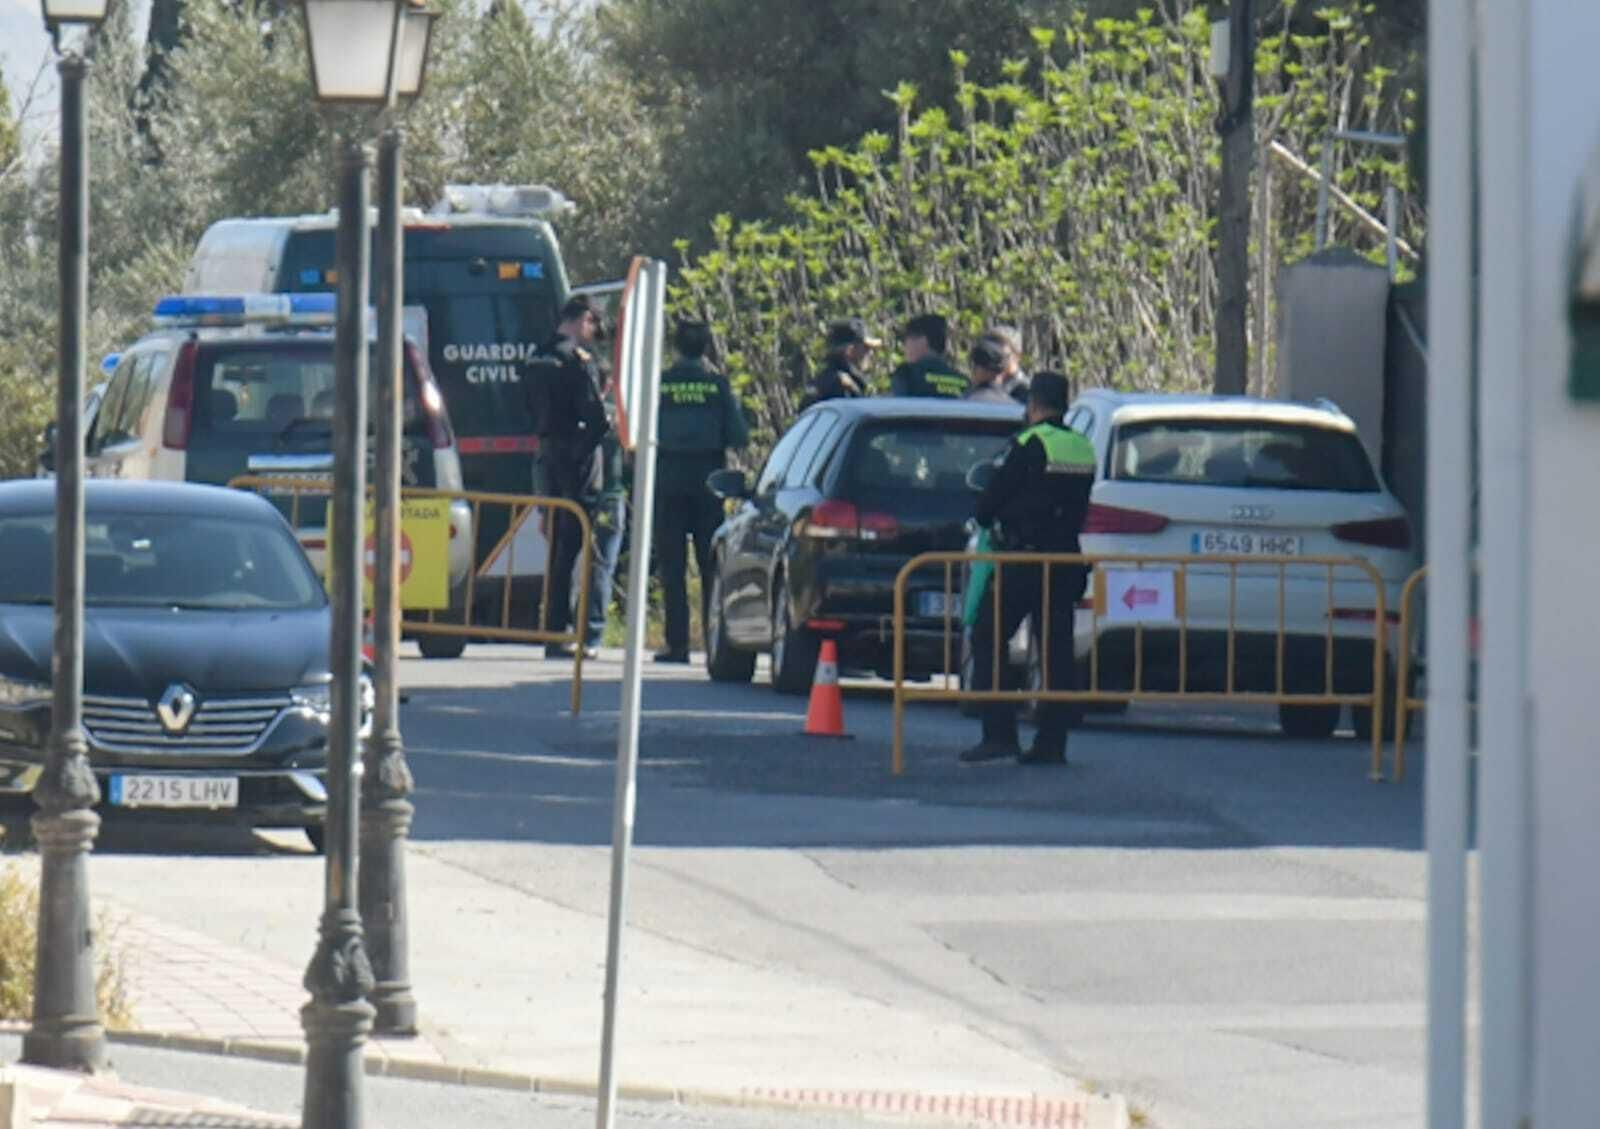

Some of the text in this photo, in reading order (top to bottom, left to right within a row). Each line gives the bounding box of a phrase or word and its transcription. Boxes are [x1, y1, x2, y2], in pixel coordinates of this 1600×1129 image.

[465, 365, 520, 383] CIVIL
[1204, 532, 1253, 554] 6549
[127, 778, 232, 801] 2215 LHV
